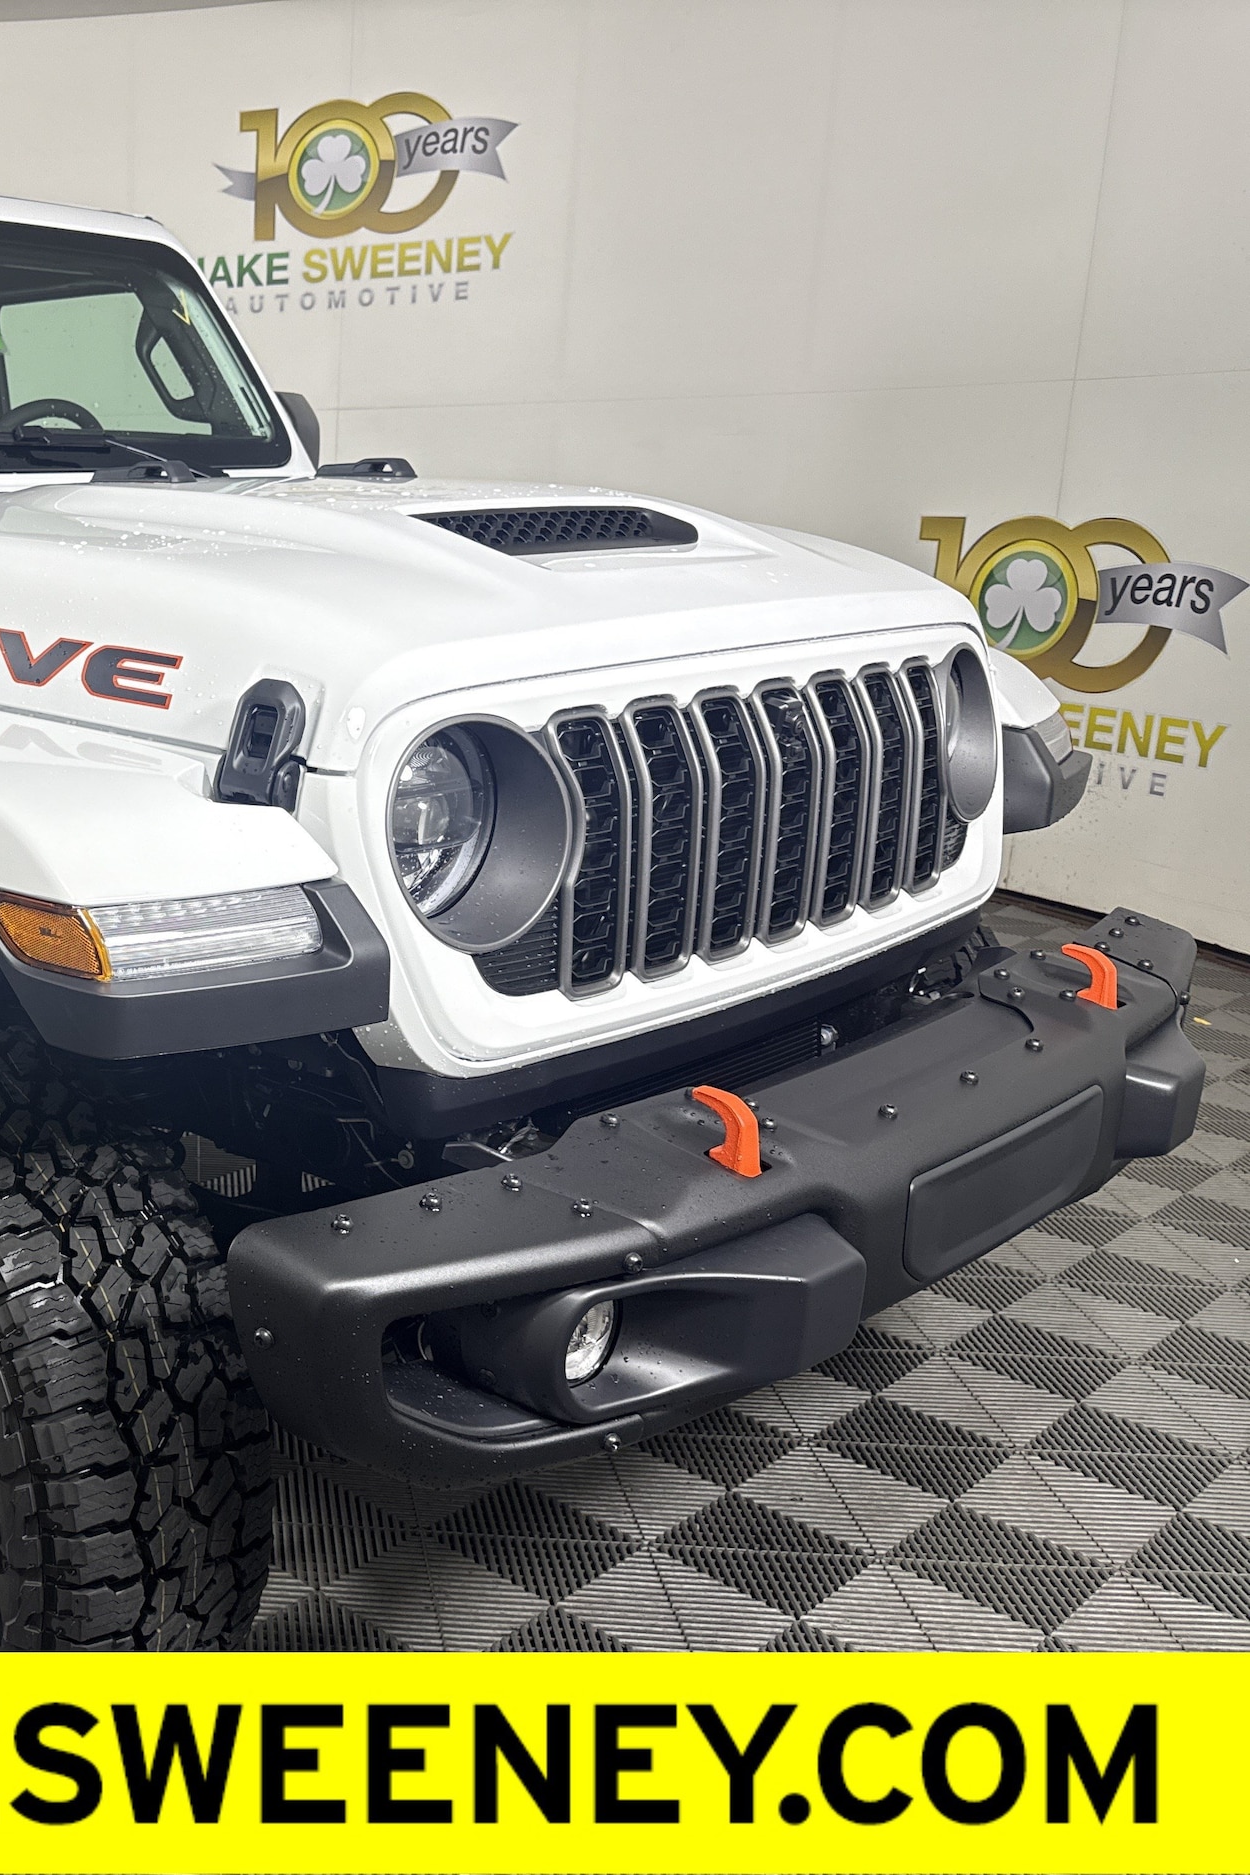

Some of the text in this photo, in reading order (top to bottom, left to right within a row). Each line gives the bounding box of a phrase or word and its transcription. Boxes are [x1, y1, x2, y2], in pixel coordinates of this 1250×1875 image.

[240, 91, 490, 241] 100 years
[303, 233, 514, 284] SWEENEY
[225, 281, 469, 315] AUTOMOTIVE
[1105, 572, 1214, 615] years
[1060, 702, 1227, 768] EENEY
